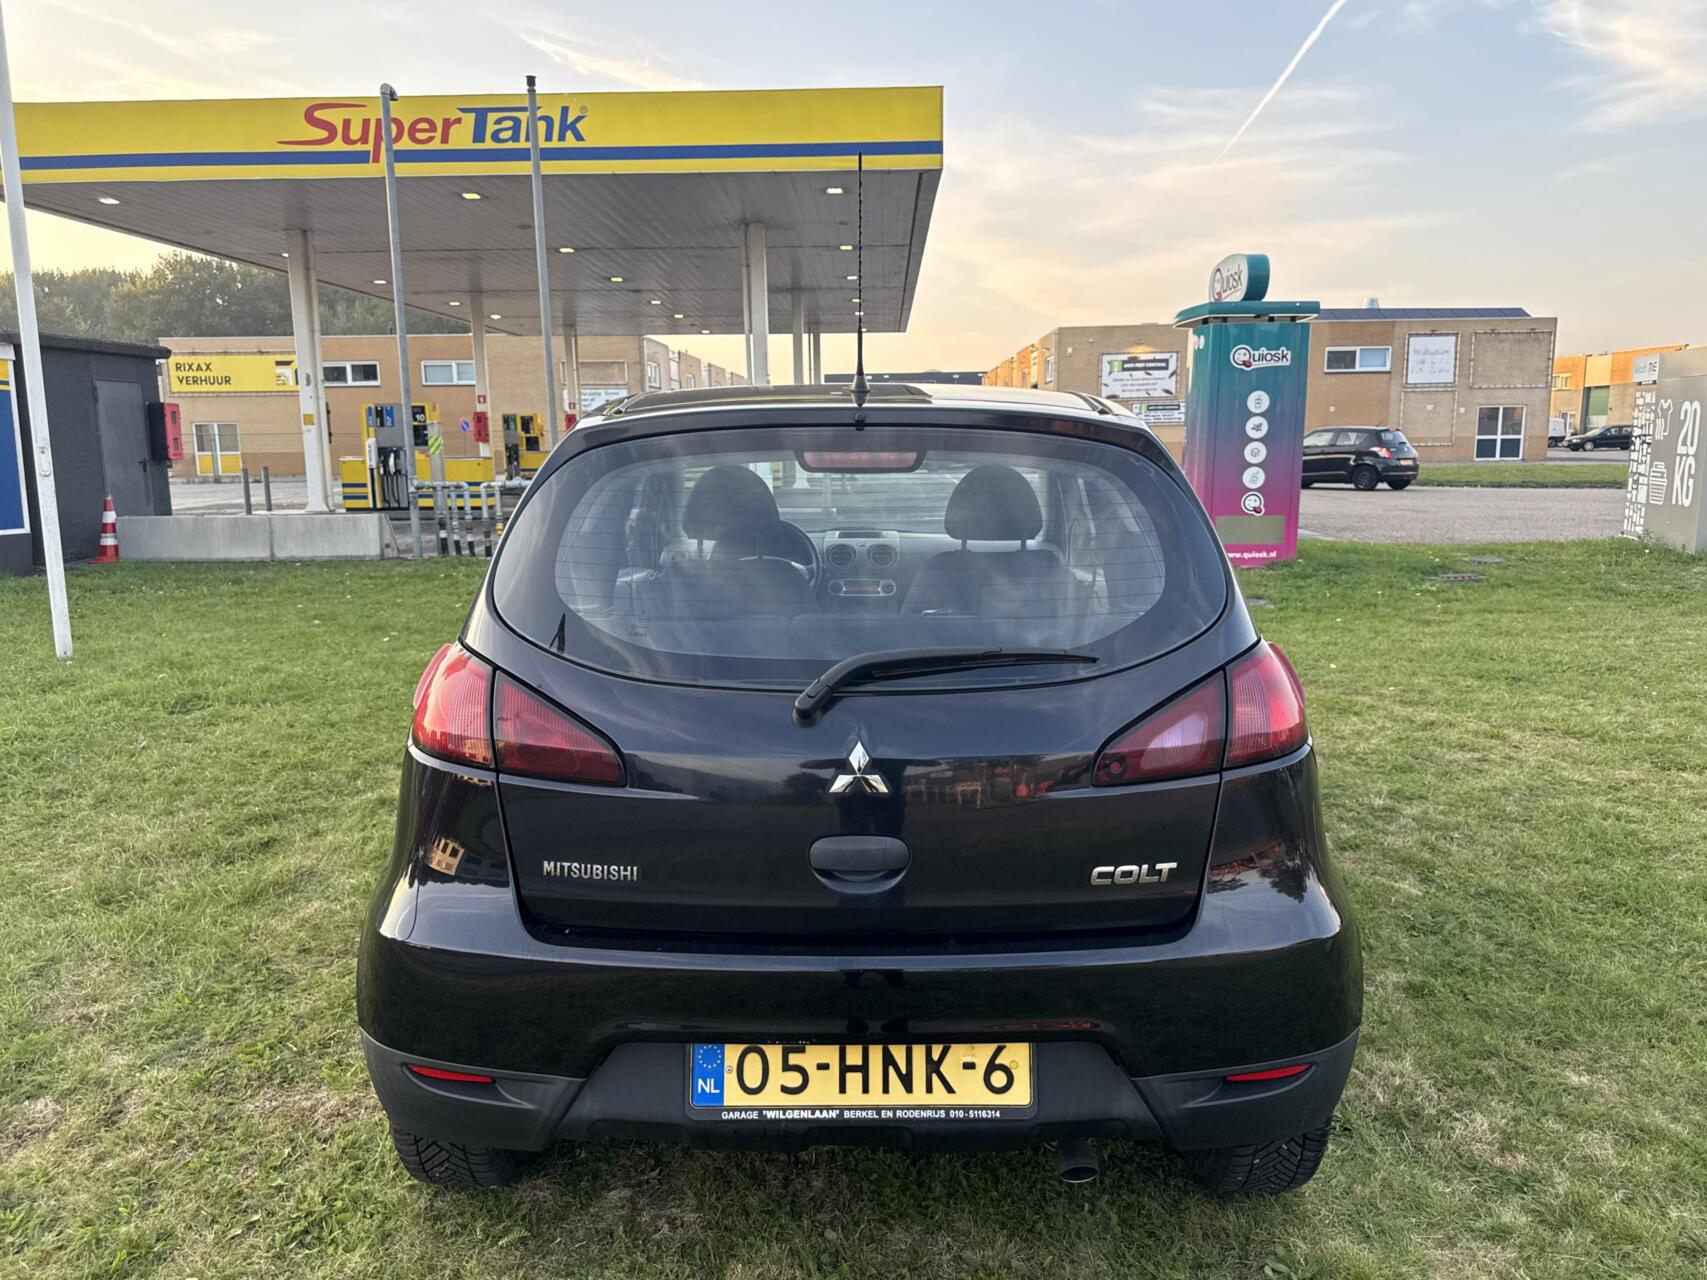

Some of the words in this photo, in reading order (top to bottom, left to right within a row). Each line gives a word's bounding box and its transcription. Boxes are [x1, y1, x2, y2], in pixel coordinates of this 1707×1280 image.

[1213, 264, 1243, 302] Quiosk
[175, 362, 212, 372] RIXAX
[1232, 347, 1290, 368] Quiosk
[177, 376, 232, 386] VERHUUR
[1677, 400, 1701, 456] 20
[1672, 455, 1696, 507] KG
[1227, 550, 1277, 560] ww.quiosk.nl
[543, 860, 638, 881] MITSUBISHI
[1090, 862, 1178, 886] COLT
[736, 1044, 1015, 1096] 05-HNK-6
[697, 1078, 720, 1094] NL
[721, 1111, 759, 1120] GARAGE
[843, 1110, 879, 1119] BERKEL
[881, 1110, 893, 1118] EN
[896, 1110, 946, 1118] RODENRIJS
